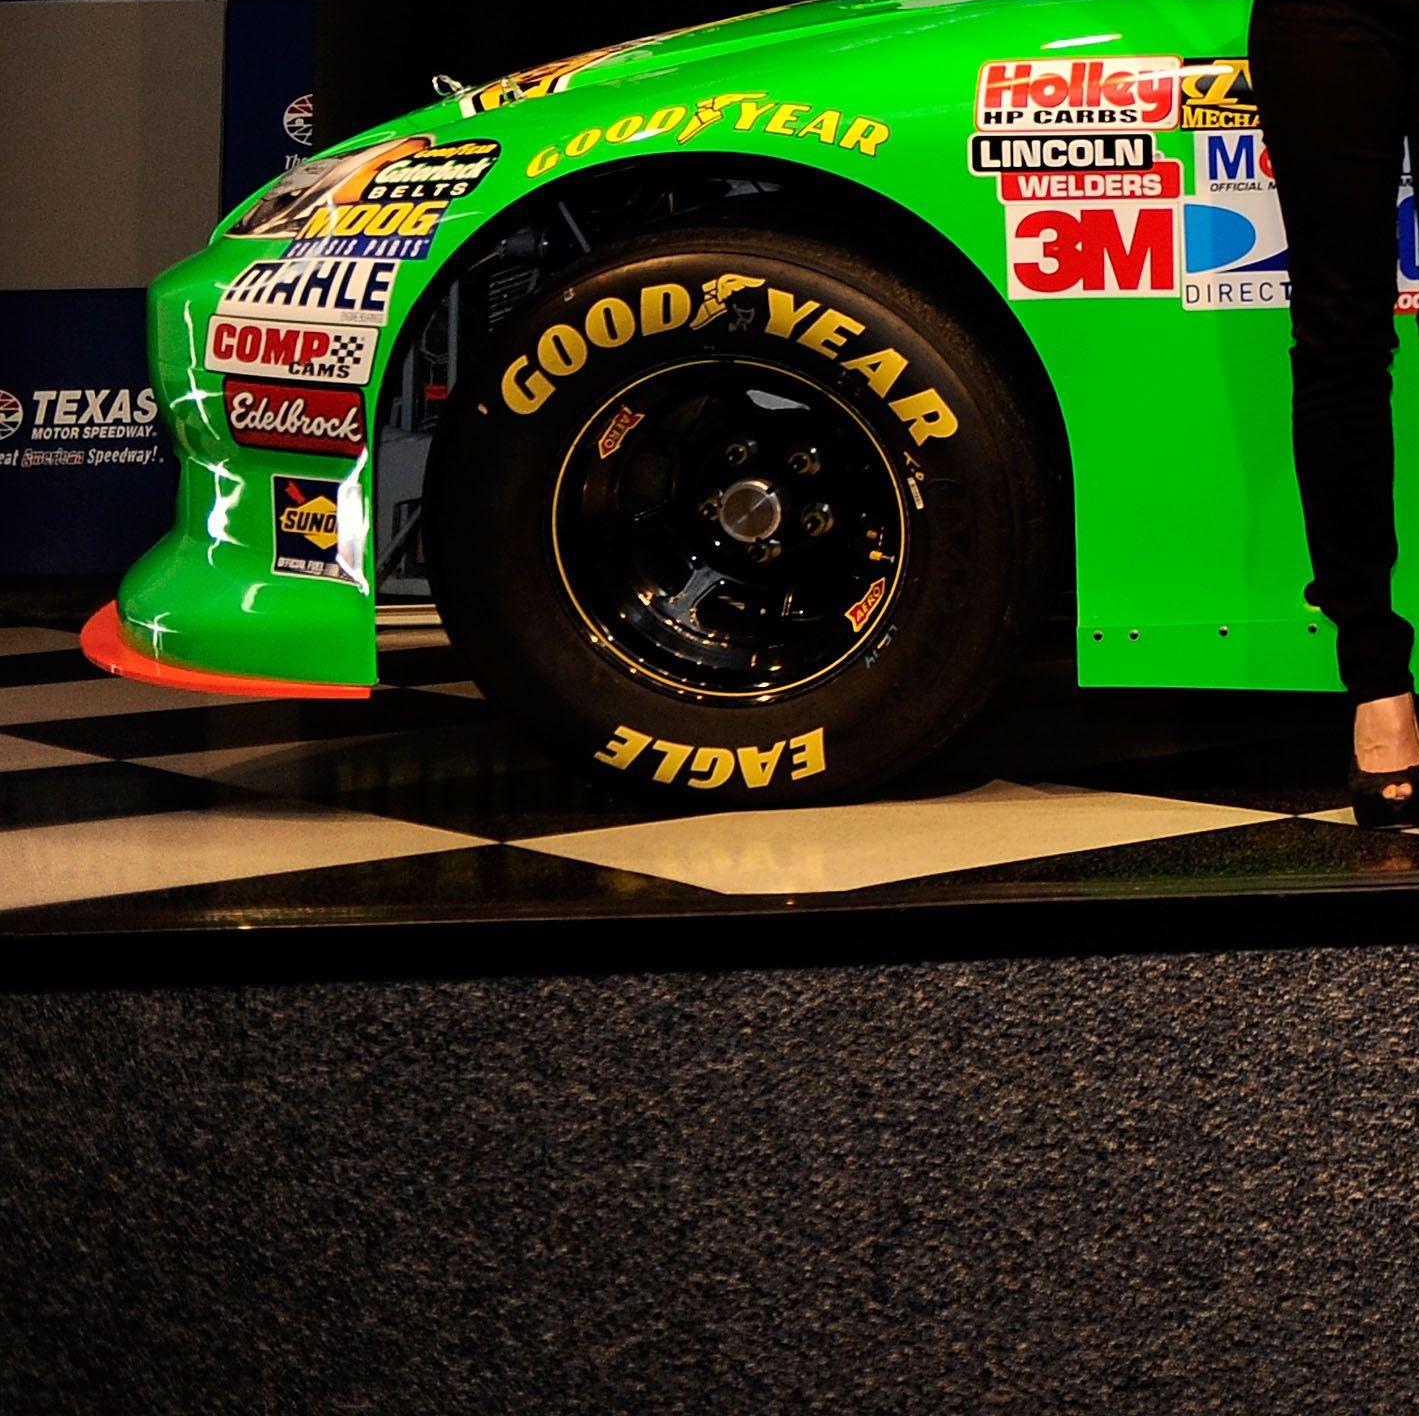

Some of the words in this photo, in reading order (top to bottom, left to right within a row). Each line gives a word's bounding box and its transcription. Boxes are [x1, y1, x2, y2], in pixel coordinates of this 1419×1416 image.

[984, 61, 1174, 123] Holley
[984, 110, 1024, 125] HP
[1033, 109, 1138, 124] CARBS
[980, 138, 1145, 168] LINCOLN
[367, 182, 469, 200] BELTS
[1018, 174, 1162, 198] WELDERS
[1210, 183, 1264, 193] OFFICIAL
[295, 200, 450, 240] MOOG
[363, 239, 423, 258] PARTS
[1013, 208, 1175, 293] 3M
[225, 261, 396, 312] MAHLE
[1186, 280, 1291, 304] DIRECT
[212, 323, 331, 366] COMP
[288, 361, 351, 378] CAMS
[33, 390, 158, 426] TEXAS
[230, 391, 363, 442] Edelbrock
[32, 427, 79, 439] MOTOR
[856, 585, 881, 623] AERO
[594, 725, 827, 789] EAGLE
